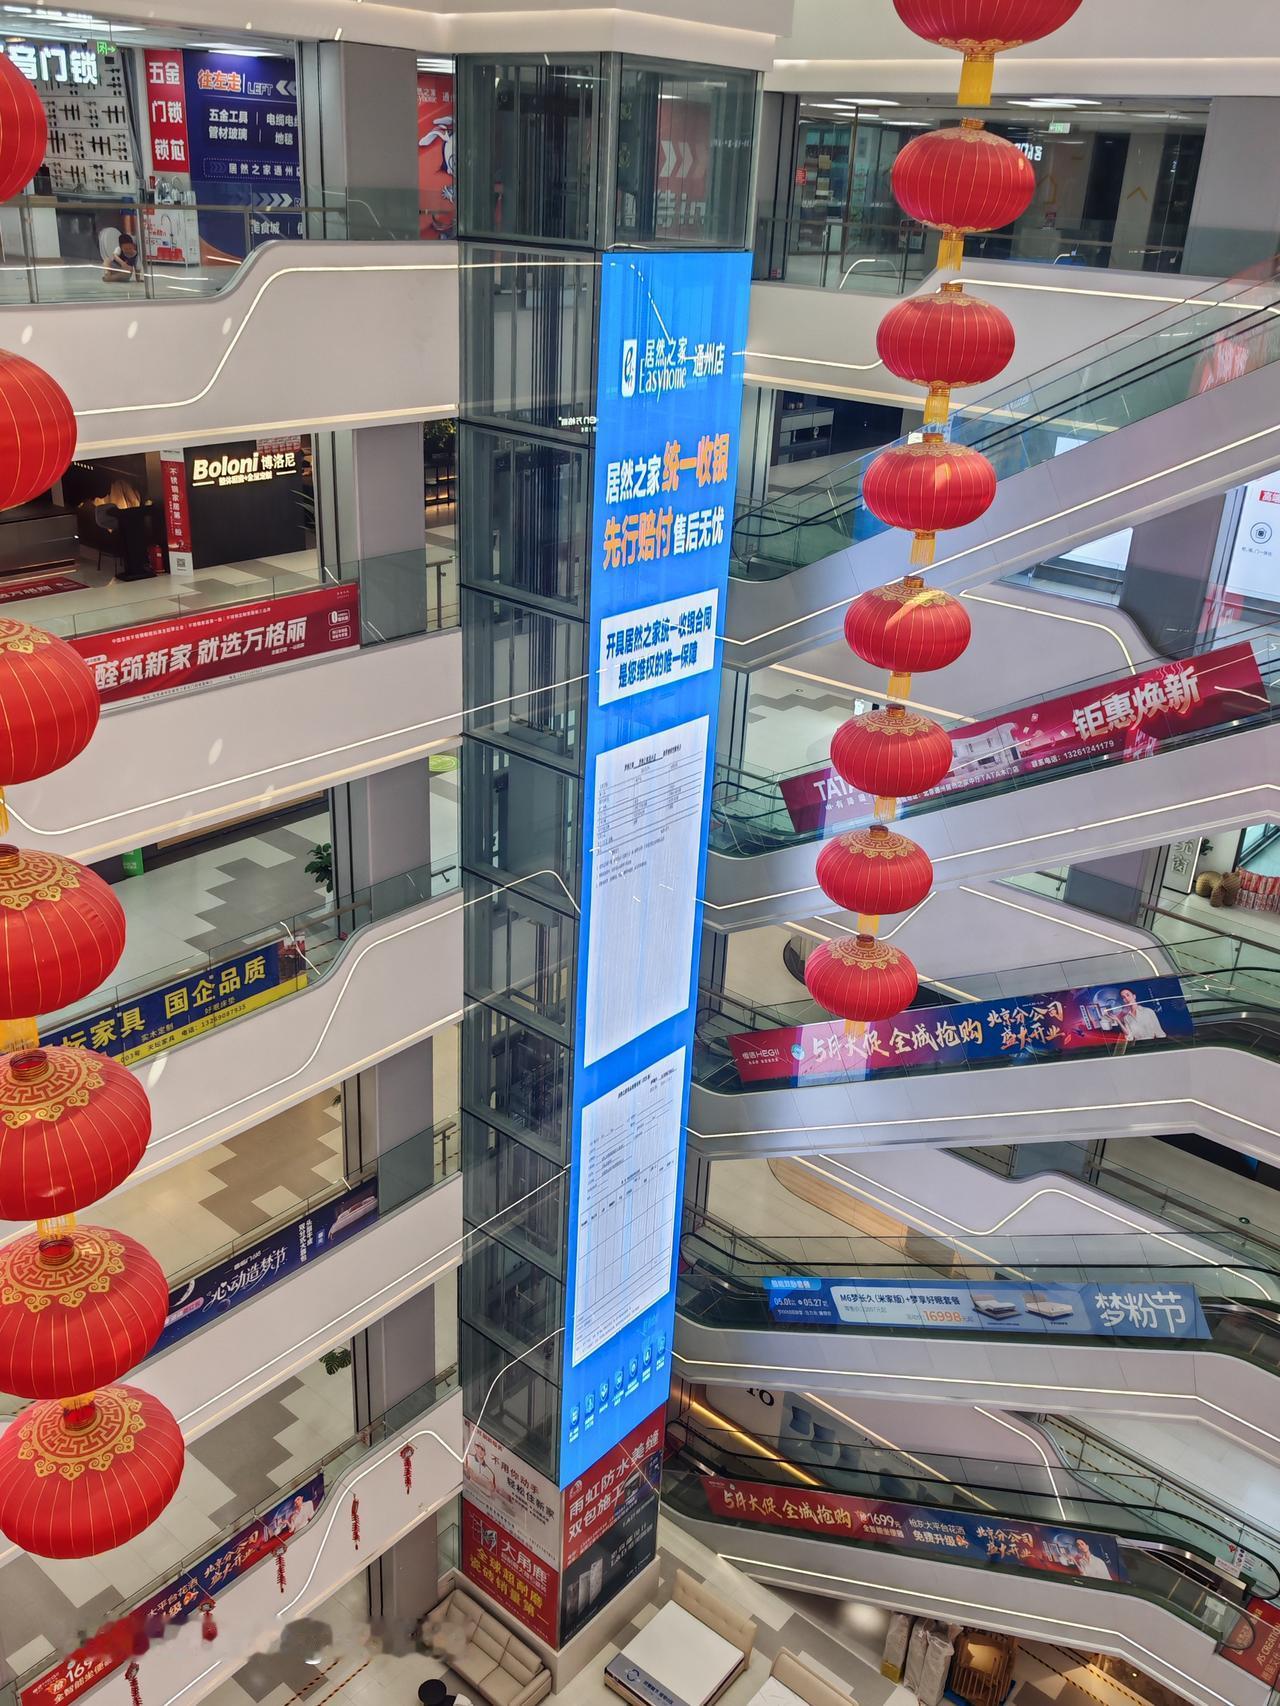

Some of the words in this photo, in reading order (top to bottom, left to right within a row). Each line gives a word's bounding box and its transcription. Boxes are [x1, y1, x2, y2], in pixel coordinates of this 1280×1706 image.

[149, 62, 180, 85] 五金
[197, 69, 241, 92] 往左走
[247, 81, 273, 96] LEFT
[152, 100, 183, 123] 门锁
[209, 109, 248, 124] 五金工具
[208, 126, 248, 141] 管材玻璃
[154, 139, 185, 161] 锁芯
[645, 336, 687, 367] 居然之家
[693, 342, 725, 377] 通州店
[639, 356, 687, 402] Easyhome
[192, 452, 258, 481] Boloni
[261, 452, 296, 471] 博洛尼
[605, 433, 730, 504] 居然之家统一收银
[197, 616, 308, 666] 就选万格丽
[618, 640, 698, 688] 是您维权的唯一保障
[1072, 665, 1200, 741] 钜惠焕新
[813, 775, 856, 801] TAT
[164, 955, 266, 1020] 国企品质
[987, 1000, 1064, 1028] 北京分公司
[889, 1017, 983, 1055] 全城抢购
[1001, 1024, 1066, 1050] 盛大开业
[923, 1310, 962, 1323] 16998
[1094, 1291, 1186, 1334] 梦粉节
[491, 1454, 539, 1495] 不用你动手
[506, 1477, 555, 1520] 轻松住新家
[782, 1499, 852, 1528] 全城抢购
[976, 1526, 1034, 1549] 北京分公司
[203, 1530, 259, 1579] 北京分公司
